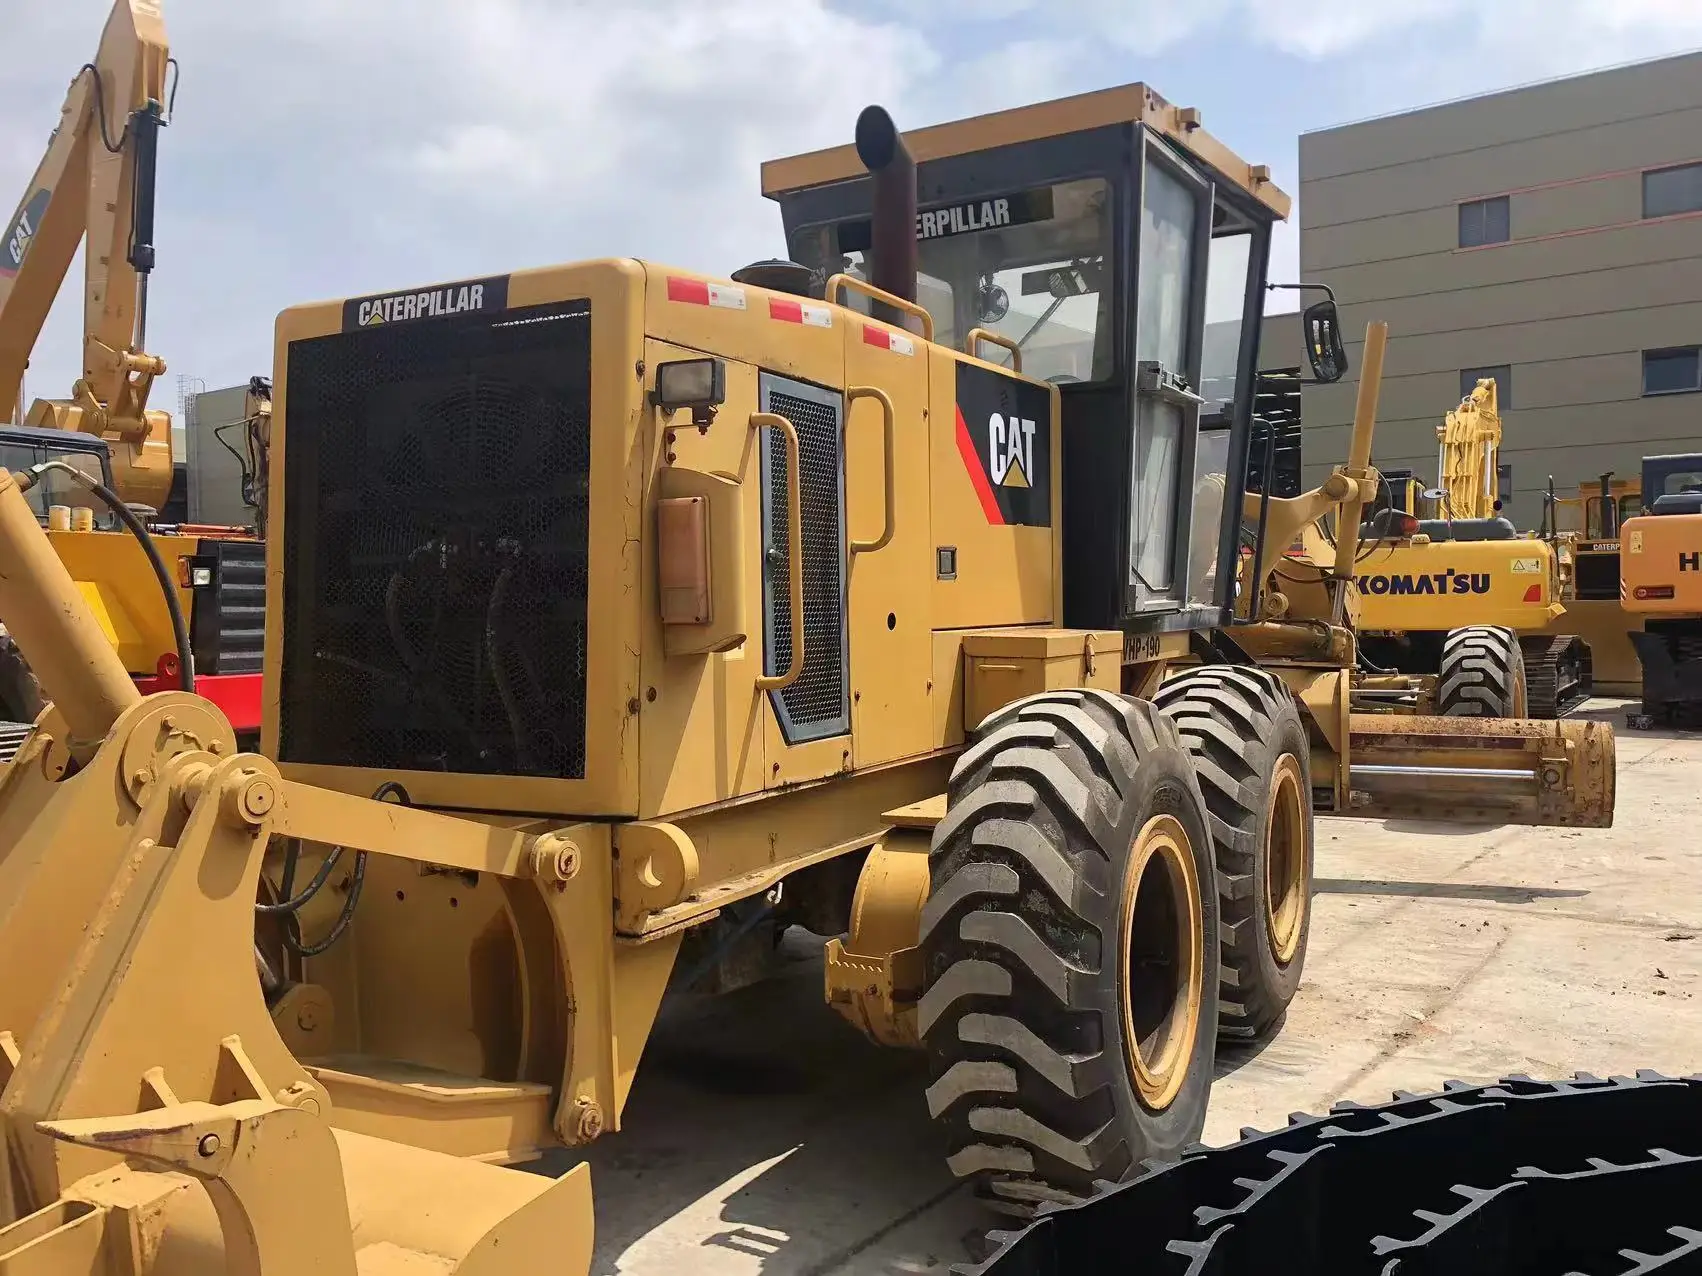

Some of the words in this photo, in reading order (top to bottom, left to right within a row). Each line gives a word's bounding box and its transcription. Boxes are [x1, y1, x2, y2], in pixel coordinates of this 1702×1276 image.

[9, 209, 32, 264] CAT
[358, 284, 484, 326] CATERPILLAR
[989, 412, 1036, 487] CAT
[1353, 568, 1490, 595] KOMATSU
